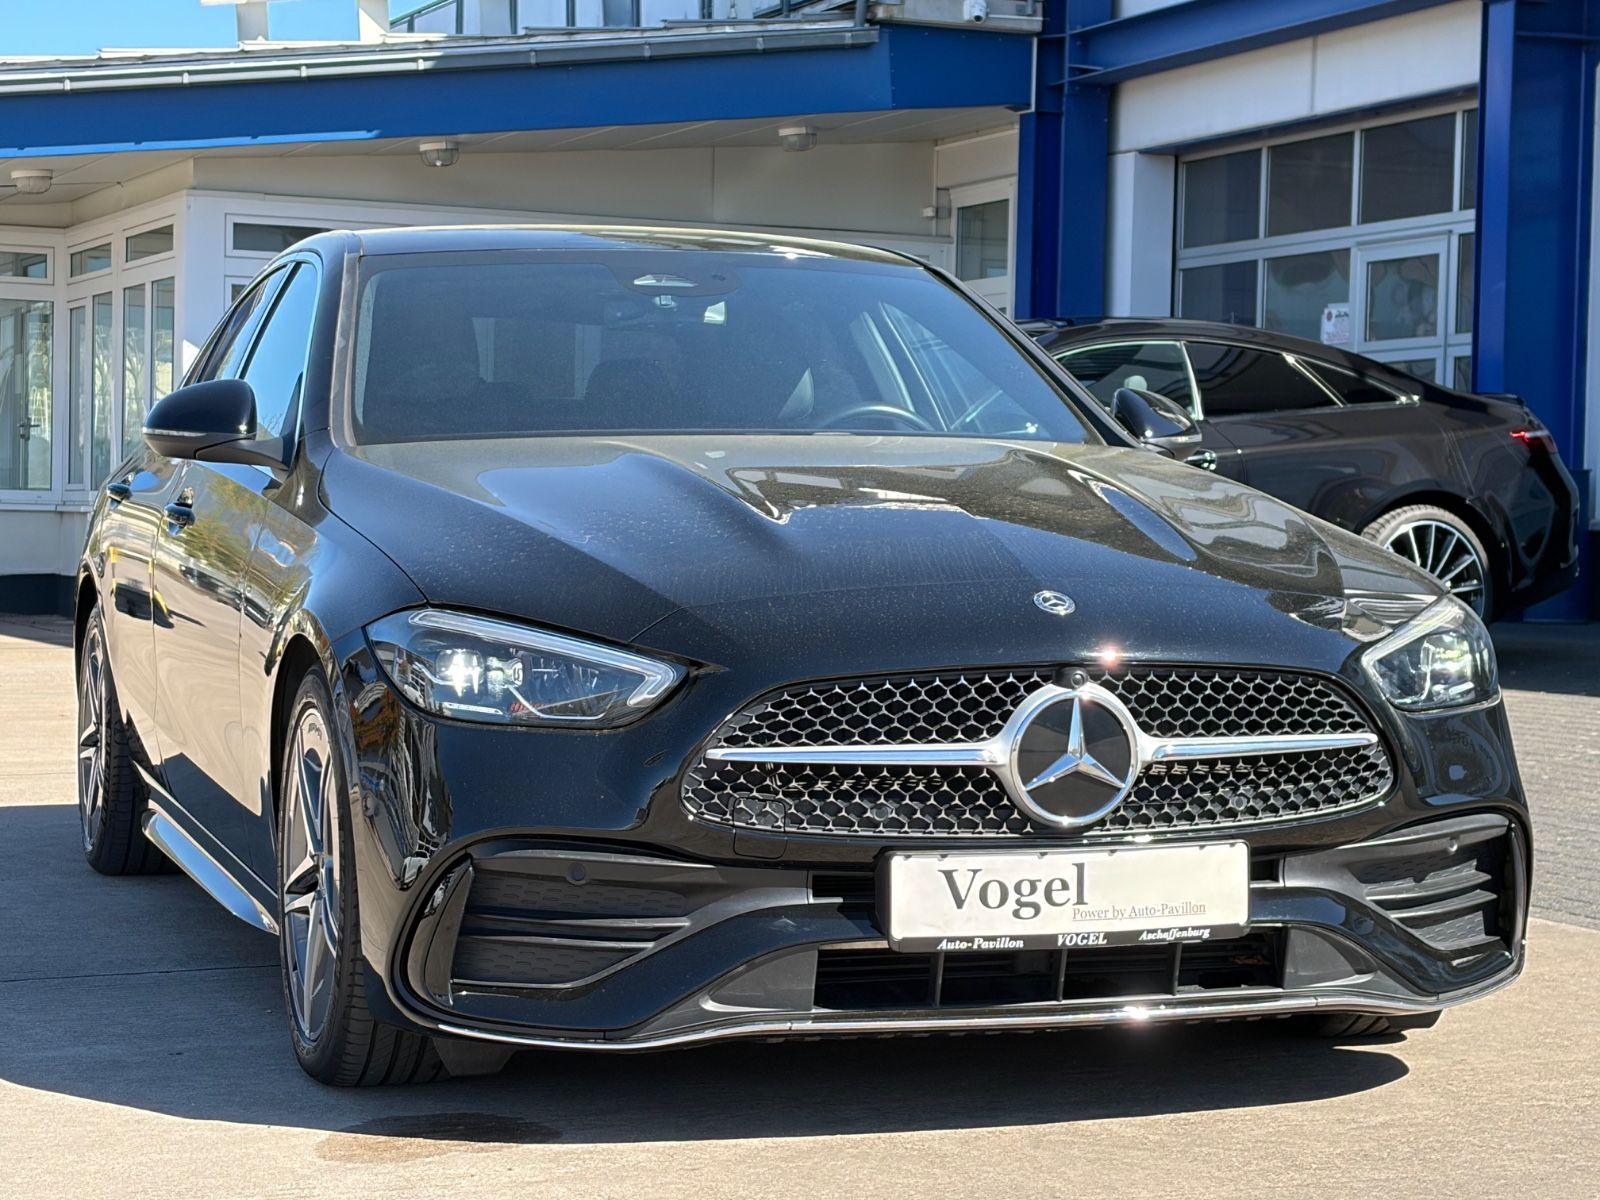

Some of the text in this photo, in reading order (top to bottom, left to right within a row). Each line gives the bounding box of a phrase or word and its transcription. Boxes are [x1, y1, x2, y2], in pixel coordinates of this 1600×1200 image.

[938, 863, 1088, 920] Vogel
[1073, 901, 1206, 921] Power by Auto-Pavillon
[937, 927, 1211, 950] Auto-Pavillon VOGEL Aschaffenburg
